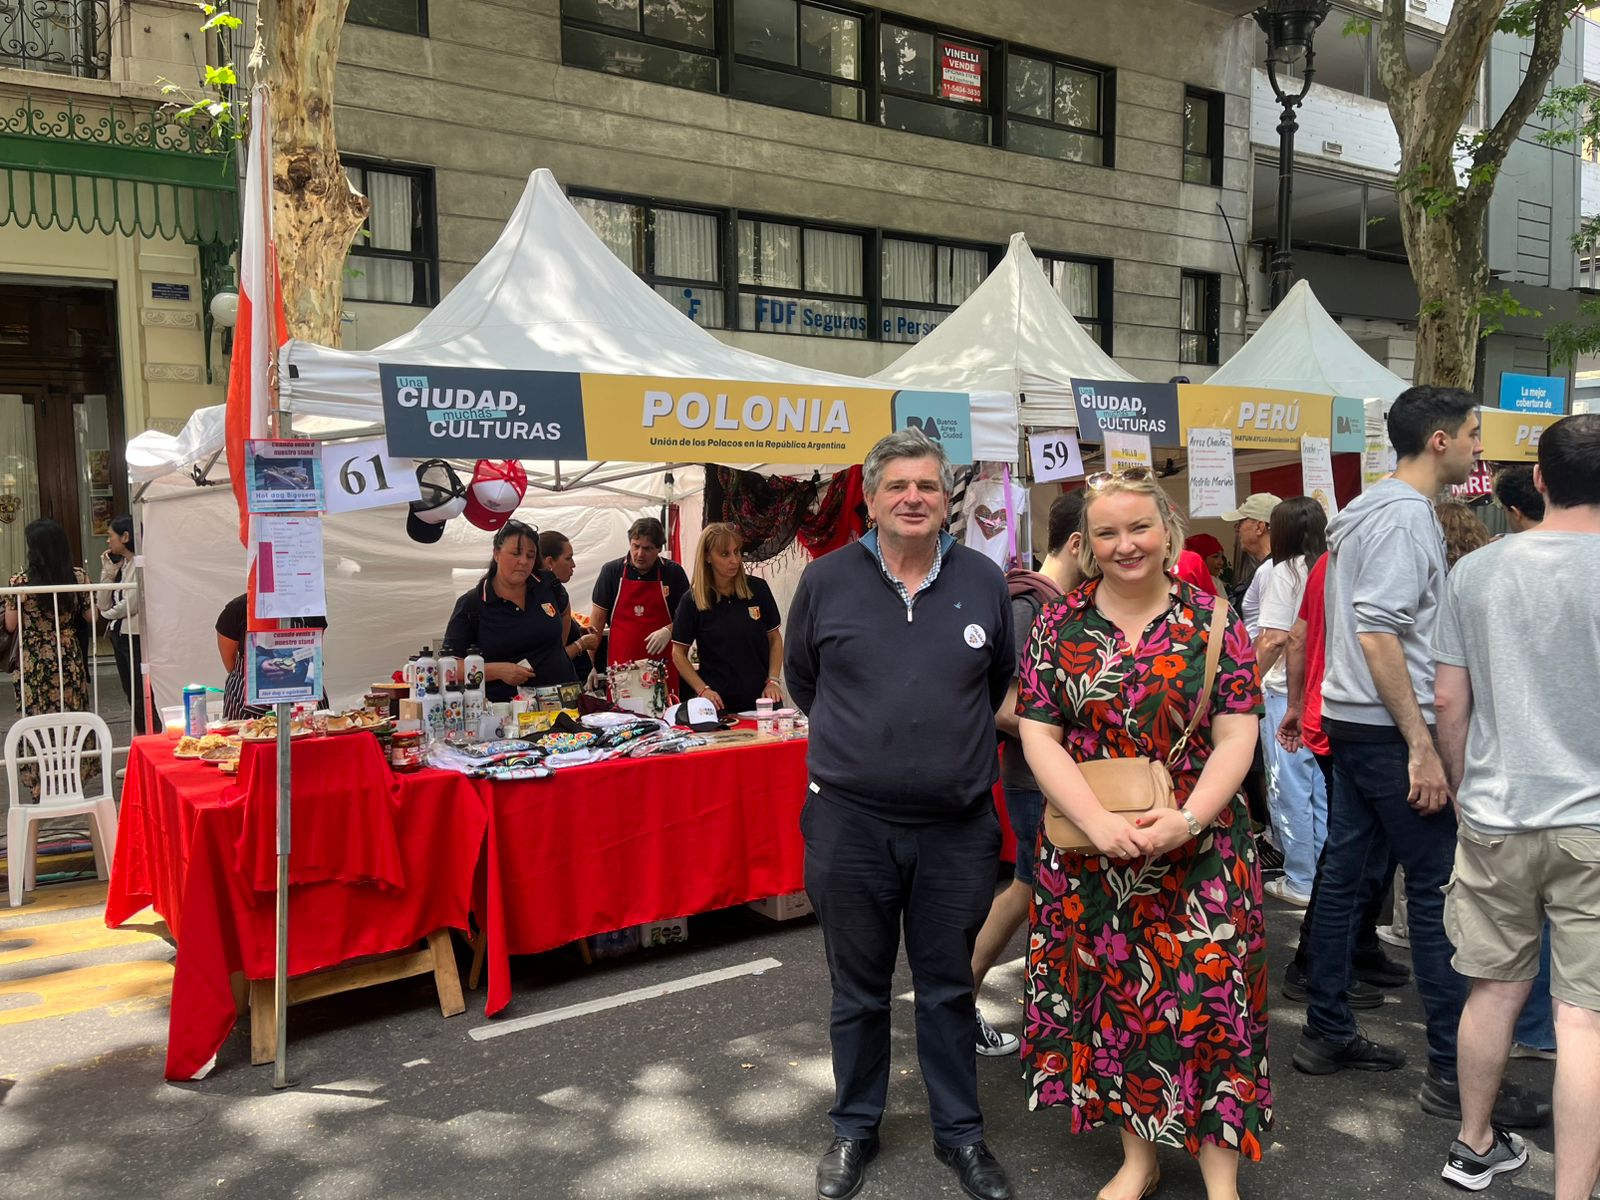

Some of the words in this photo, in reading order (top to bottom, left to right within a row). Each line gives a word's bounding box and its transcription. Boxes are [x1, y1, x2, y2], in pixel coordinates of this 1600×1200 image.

[944, 47, 979, 63] VINELLI
[949, 59, 976, 72] VENDE
[759, 298, 797, 325] FDF
[803, 308, 867, 332] Seguros
[897, 317, 938, 336] Perso
[399, 377, 424, 388] Una
[397, 387, 526, 416] CIUDAD,
[1521, 386, 1529, 397] La
[1529, 387, 1547, 399] mejor
[641, 390, 851, 433] POLONIA
[1080, 394, 1147, 415] CIUDAD,
[1516, 398, 1544, 409] cobertura
[1543, 399, 1552, 409] de
[442, 408, 493, 420] muchas
[1236, 399, 1300, 431] PERÚ
[429, 420, 561, 441] CULTURAS
[1098, 416, 1167, 433] CULTURAS
[1336, 416, 1352, 434] BA
[649, 437, 678, 447] Unión
[679, 438, 692, 447] de
[692, 438, 706, 447] los
[707, 438, 743, 448] Polacos
[755, 439, 764, 448] la
[764, 438, 806, 450] República
[806, 440, 846, 451] Argentina
[1515, 424, 1544, 447] PE
[1042, 440, 1069, 471] 59
[338, 454, 394, 495] 61
